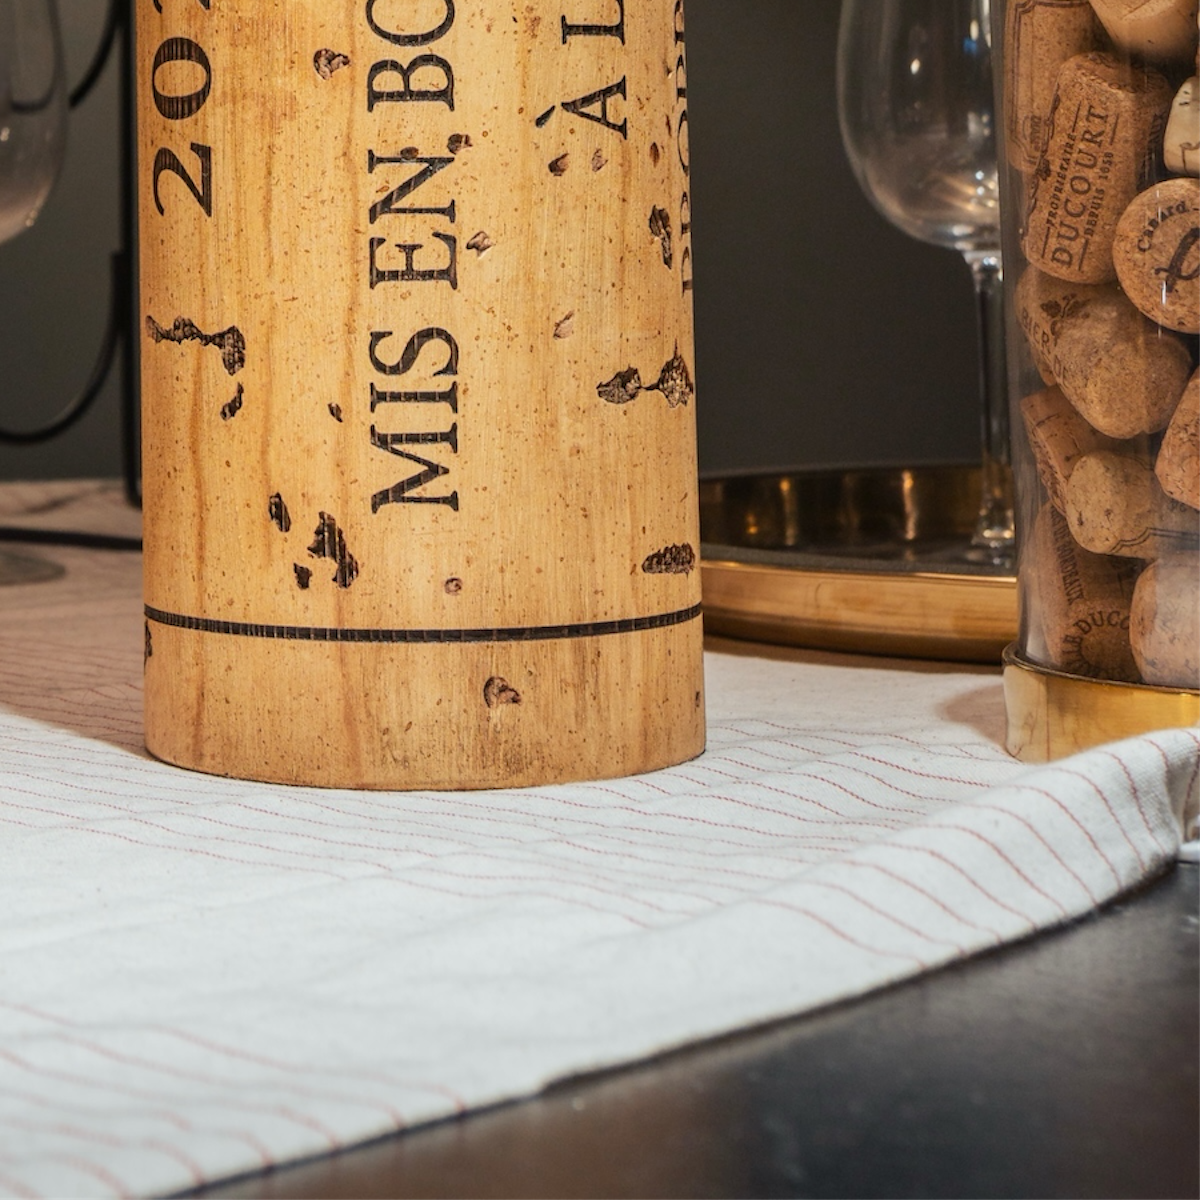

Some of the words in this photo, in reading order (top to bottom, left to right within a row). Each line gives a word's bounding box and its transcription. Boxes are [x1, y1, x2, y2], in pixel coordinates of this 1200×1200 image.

[535, 74, 627, 140] À
[367, 148, 458, 290] EN
[1051, 104, 1108, 269] DUCOURT
[1084, 188, 1105, 237] DEPUIS
[370, 327, 459, 514] MIS
